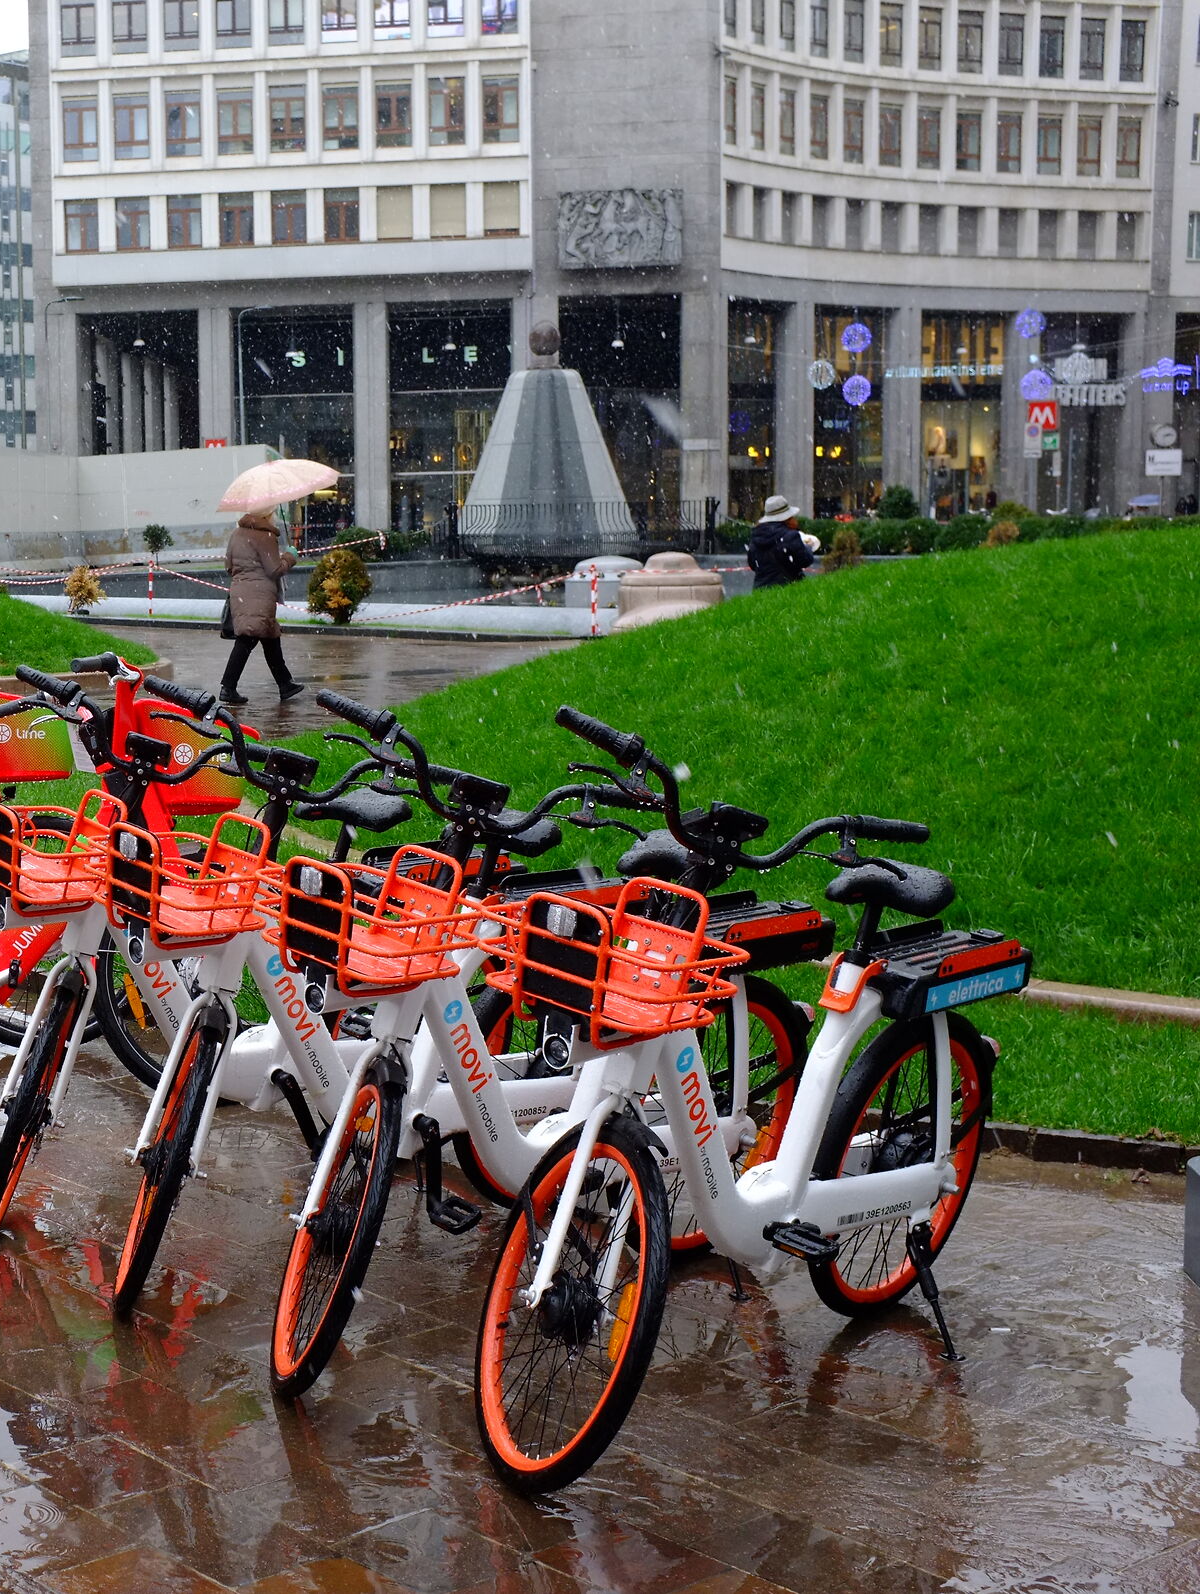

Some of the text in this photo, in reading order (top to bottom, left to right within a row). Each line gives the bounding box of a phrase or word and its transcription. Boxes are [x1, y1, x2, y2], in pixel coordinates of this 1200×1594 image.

[1029, 406, 1055, 427] M
[16, 728, 46, 740] Lime
[12, 924, 44, 957] JUM
[143, 961, 176, 999] ovi
[161, 998, 168, 1007] by
[948, 974, 1004, 1004] elettrica
[274, 975, 330, 1088] movi by mobike
[449, 1023, 499, 1142] movi by mobike
[511, 1106, 547, 1118] 1200852
[681, 1071, 718, 1147] movi
[702, 1157, 719, 1200] mobike
[865, 1201, 912, 1220] 39E1200563
